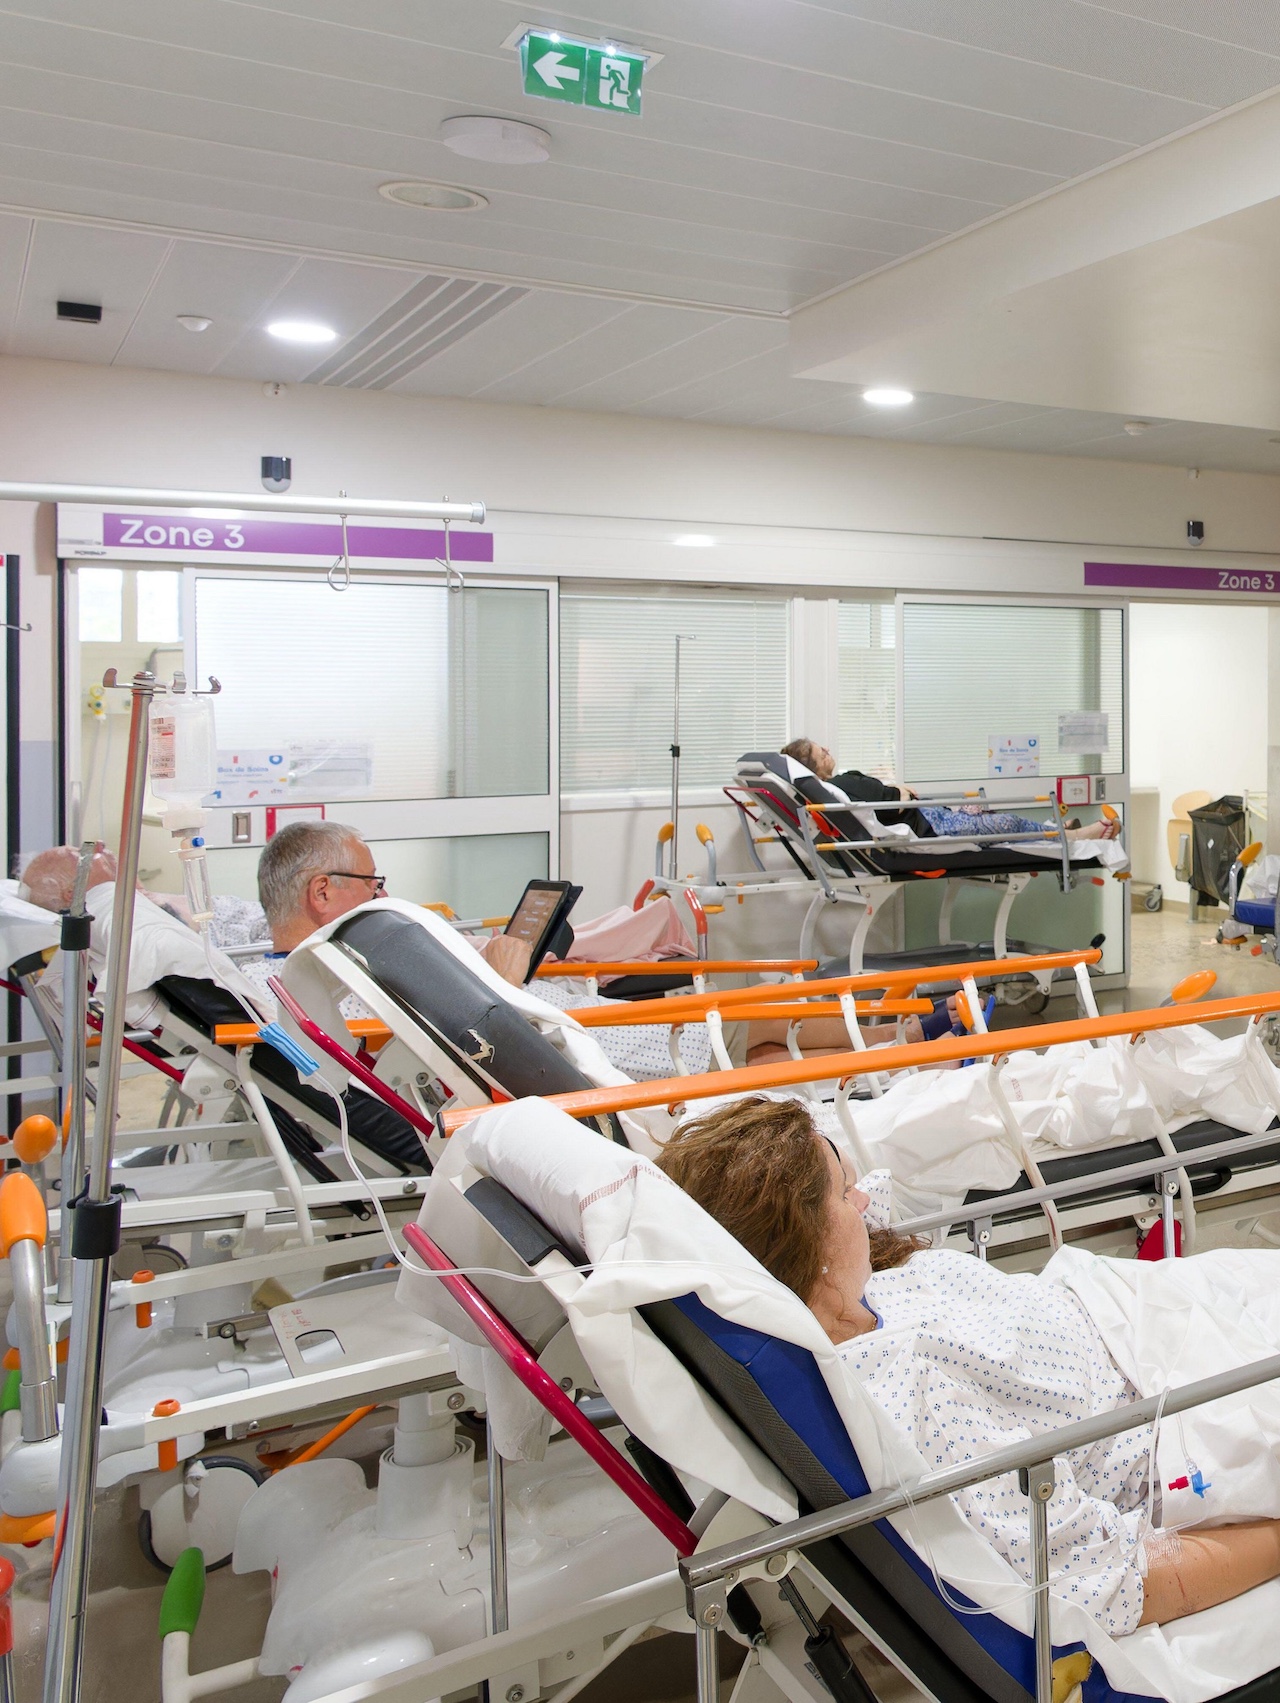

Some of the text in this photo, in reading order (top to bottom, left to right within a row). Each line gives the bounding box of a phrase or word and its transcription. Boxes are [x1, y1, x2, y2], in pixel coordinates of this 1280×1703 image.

[119, 518, 245, 549] Zone 3
[1218, 571, 1275, 590] Zone 3
